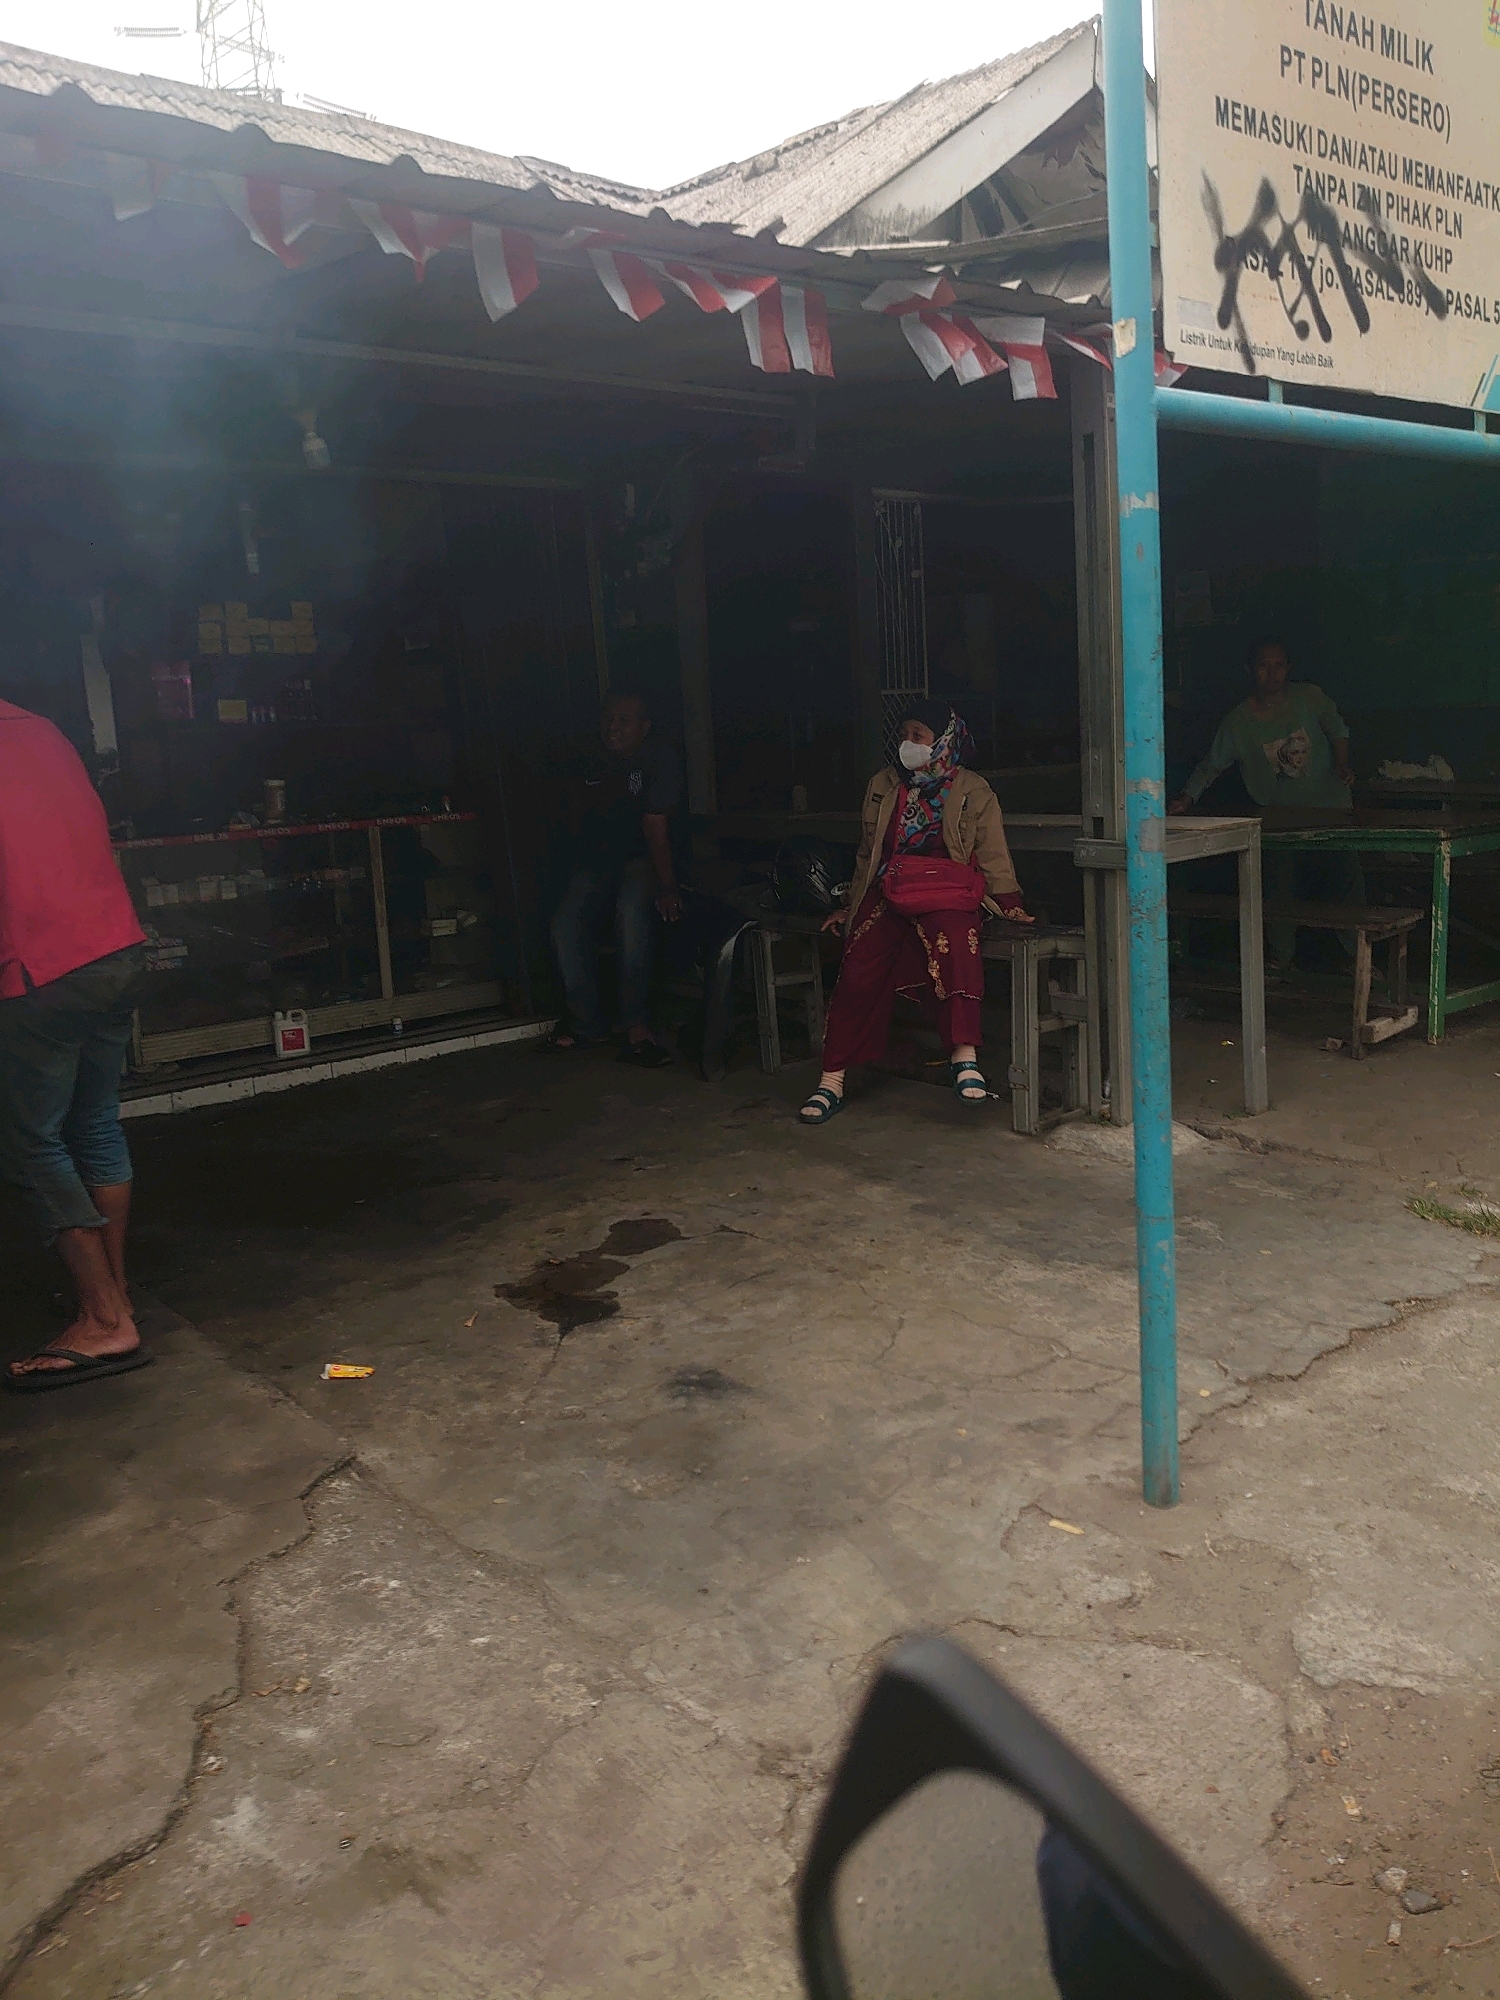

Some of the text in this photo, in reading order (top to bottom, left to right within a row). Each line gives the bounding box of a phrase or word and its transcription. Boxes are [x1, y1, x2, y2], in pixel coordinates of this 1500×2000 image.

[1304, 0, 1434, 75] TANAH MILIK
[1279, 44, 1451, 144] PT PLN(PERSERO)
[1214, 96, 1500, 213] MEMASUKI DAN/ATAU MEMANFAATK
[1292, 164, 1463, 240] TANPA IZIN PIHAK PLN
[1318, 257, 1340, 294] jo.
[1445, 288, 1491, 323] PASAL
[1413, 239, 1453, 274] KUHP
[1179, 329, 1334, 369] Listrik Untuk Kidupan Yang Lebih Baik
